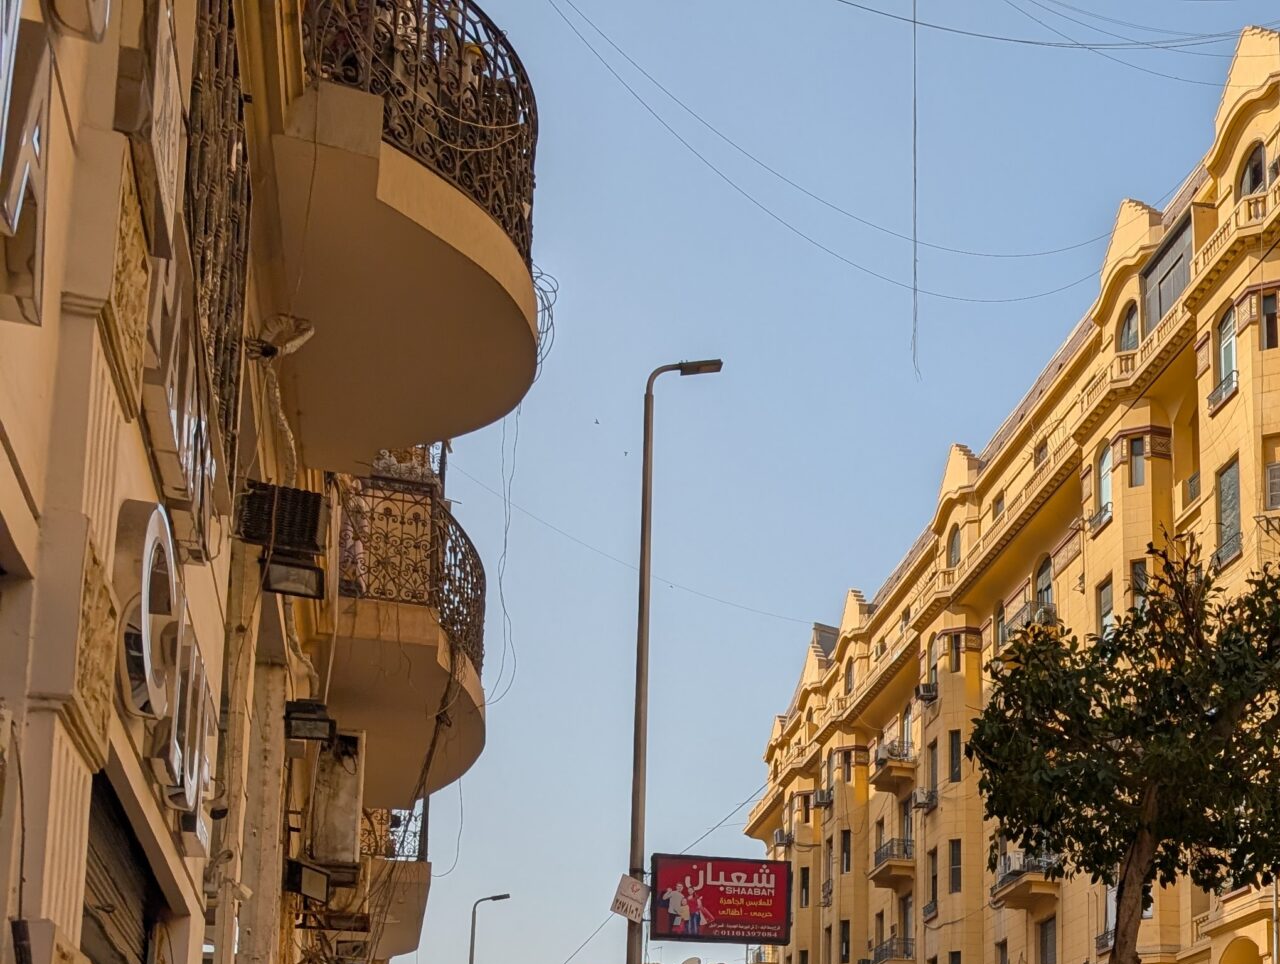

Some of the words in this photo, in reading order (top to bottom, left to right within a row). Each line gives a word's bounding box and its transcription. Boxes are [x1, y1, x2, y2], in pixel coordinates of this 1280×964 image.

[685, 862, 775, 892] شعبان
[725, 886, 775, 896] SHAABAN
[719, 896, 744, 906] الجاهزة
[745, 897, 773, 907] للملابس
